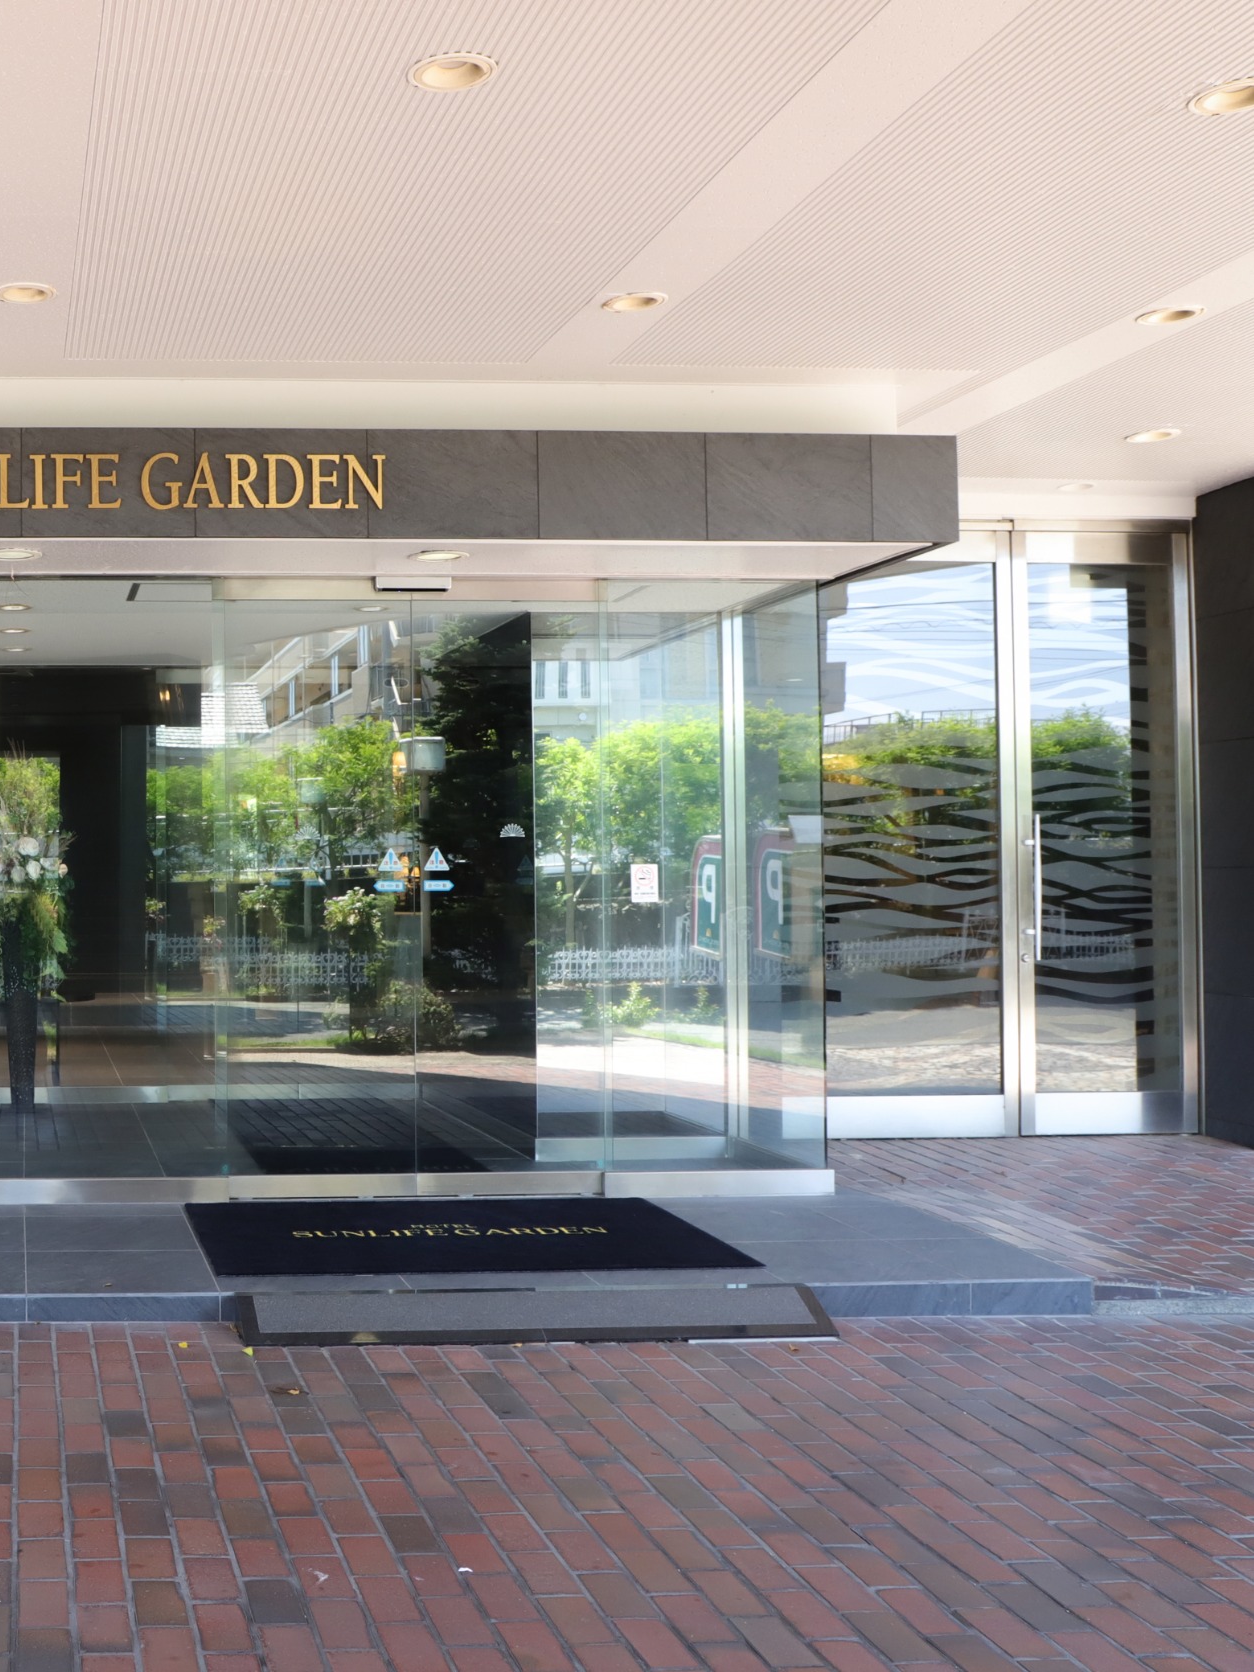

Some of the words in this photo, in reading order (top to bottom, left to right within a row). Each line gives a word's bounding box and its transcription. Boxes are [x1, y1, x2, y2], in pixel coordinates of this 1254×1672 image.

[140, 451, 387, 512] GARDEN
[292, 1228, 449, 1238] SUNLIFE
[454, 1226, 608, 1236] GARDEN
